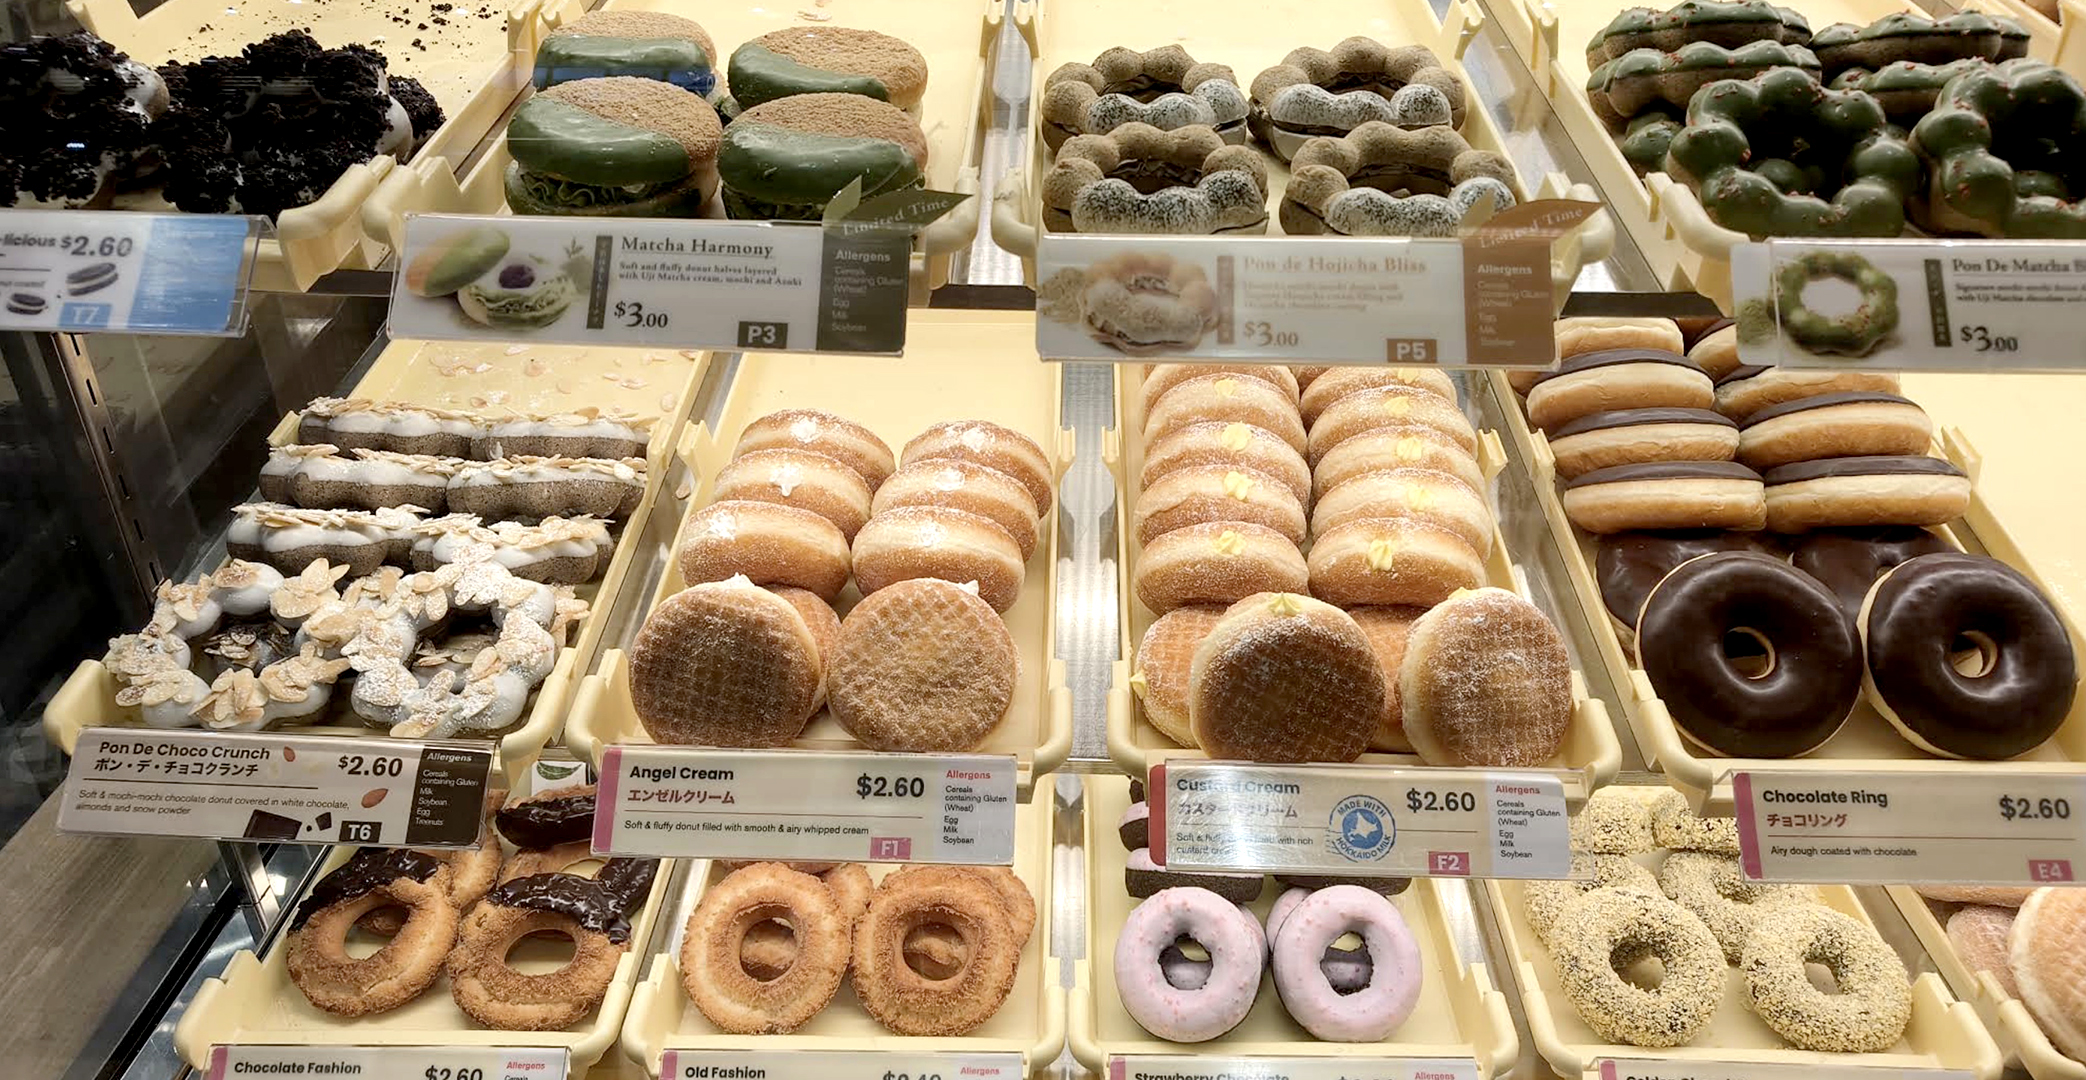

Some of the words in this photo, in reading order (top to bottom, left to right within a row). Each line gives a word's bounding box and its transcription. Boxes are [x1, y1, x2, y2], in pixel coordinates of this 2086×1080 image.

[842, 209, 904, 236] Limited
[908, 200, 949, 215] Time
[1542, 208, 1583, 225] Time
[61, 236, 133, 257] $2.60
[621, 237, 684, 251] Matcha
[691, 239, 774, 259] Harmony
[835, 250, 891, 263] Allergens
[1244, 256, 1276, 270] Pon
[1283, 256, 1301, 270] de
[1309, 256, 1378, 273] Hojicha
[1385, 256, 1427, 273] Bliss
[1953, 259, 1981, 272] Pon
[1986, 259, 2008, 272] De
[2013, 259, 2070, 273] Matcha
[658, 273, 690, 282] Matcha
[73, 306, 97, 324] T7
[614, 301, 668, 328] $3.00
[748, 326, 776, 343] P3
[1244, 321, 1299, 347] $3.00
[1961, 326, 2018, 352] $3.00
[1396, 342, 1426, 360] P5
[99, 742, 129, 755] Pon
[134, 743, 154, 755] De
[157, 744, 208, 758] Choco
[212, 746, 270, 760] Crunch
[427, 752, 473, 764] Allergens
[94, 757, 259, 777] ポン・デ・チョコクランチ
[338, 755, 403, 778] $2.60
[422, 769, 449, 778] Cereals
[629, 766, 676, 782] Angel
[680, 767, 735, 781] Cream
[946, 770, 991, 781] Allergens
[421, 777, 455, 787] containing
[455, 778, 479, 787] Gluten
[856, 773, 925, 799] $2.60
[945, 785, 973, 793] Cereals
[1245, 781, 1300, 795] Cream
[419, 787, 434, 796] Milk
[627, 789, 736, 805] エンゼルクリーム
[1495, 785, 1541, 795] Allergens
[79, 790, 98, 799] Soft
[99, 791, 106, 799] &
[108, 792, 163, 802] mochi-mochi
[164, 794, 206, 804] chocolate
[208, 795, 233, 805] donut
[234, 797, 270, 806] covered
[271, 798, 279, 806] in
[280, 799, 305, 808] white
[306, 800, 350, 811] chocolate,
[418, 797, 448, 807] Soybean
[945, 794, 982, 804] containing
[984, 795, 1008, 803] Gluten
[1406, 787, 1476, 813] $2.60
[1496, 800, 1525, 808] Cereals
[1763, 790, 1848, 804] Chocolate
[1851, 791, 1888, 808] Ring
[75, 803, 112, 812] almonds
[114, 804, 132, 812] and
[132, 806, 156, 814] snow
[158, 806, 192, 815] powder
[416, 807, 431, 817] Egg
[944, 803, 974, 813] (Wheat)
[1337, 800, 1362, 817] MADE
[1363, 800, 1387, 818] WITH
[1497, 808, 1535, 818] containing
[1536, 809, 1561, 817] Gluten
[1999, 794, 2070, 821] $2.60
[943, 815, 958, 825] Egg
[1498, 818, 1528, 827] (Wheat)
[1767, 813, 1848, 828] チョコリング
[348, 823, 372, 841] T6
[624, 820, 643, 830] Soft
[644, 821, 652, 830] &
[653, 820, 674, 832] fluffy
[675, 822, 700, 832] donut
[702, 822, 722, 832] filled
[724, 823, 743, 832] with
[744, 823, 776, 833] smooth
[777, 824, 785, 833] &
[786, 825, 802, 835] airy
[804, 825, 841, 837] whipped
[842, 827, 869, 835] cream
[943, 825, 958, 834] Milk
[1499, 830, 1514, 839] Egg
[881, 841, 898, 855] F1
[943, 836, 974, 846] Soybean
[1277, 836, 1296, 845] with
[1298, 837, 1314, 846] rich
[1336, 837, 1378, 860] HOKKAIDO
[1377, 834, 1392, 854] MILK
[1500, 840, 1515, 848] Milk
[1500, 850, 1533, 860] Soybean
[1771, 846, 1788, 857] Airy
[1789, 846, 1819, 857] dough
[1820, 847, 1850, 856] coated
[1852, 848, 1872, 856] with
[1437, 855, 1460, 870] F2
[2038, 863, 2063, 879] E4
[234, 1061, 305, 1074] Chocolate
[307, 1061, 362, 1075] Fashion
[425, 1065, 483, 1080] $260
[506, 1061, 546, 1071] Allergens
[685, 1066, 709, 1079] Old
[711, 1066, 766, 1079] Fashion
[960, 1066, 1000, 1076] Allergens
